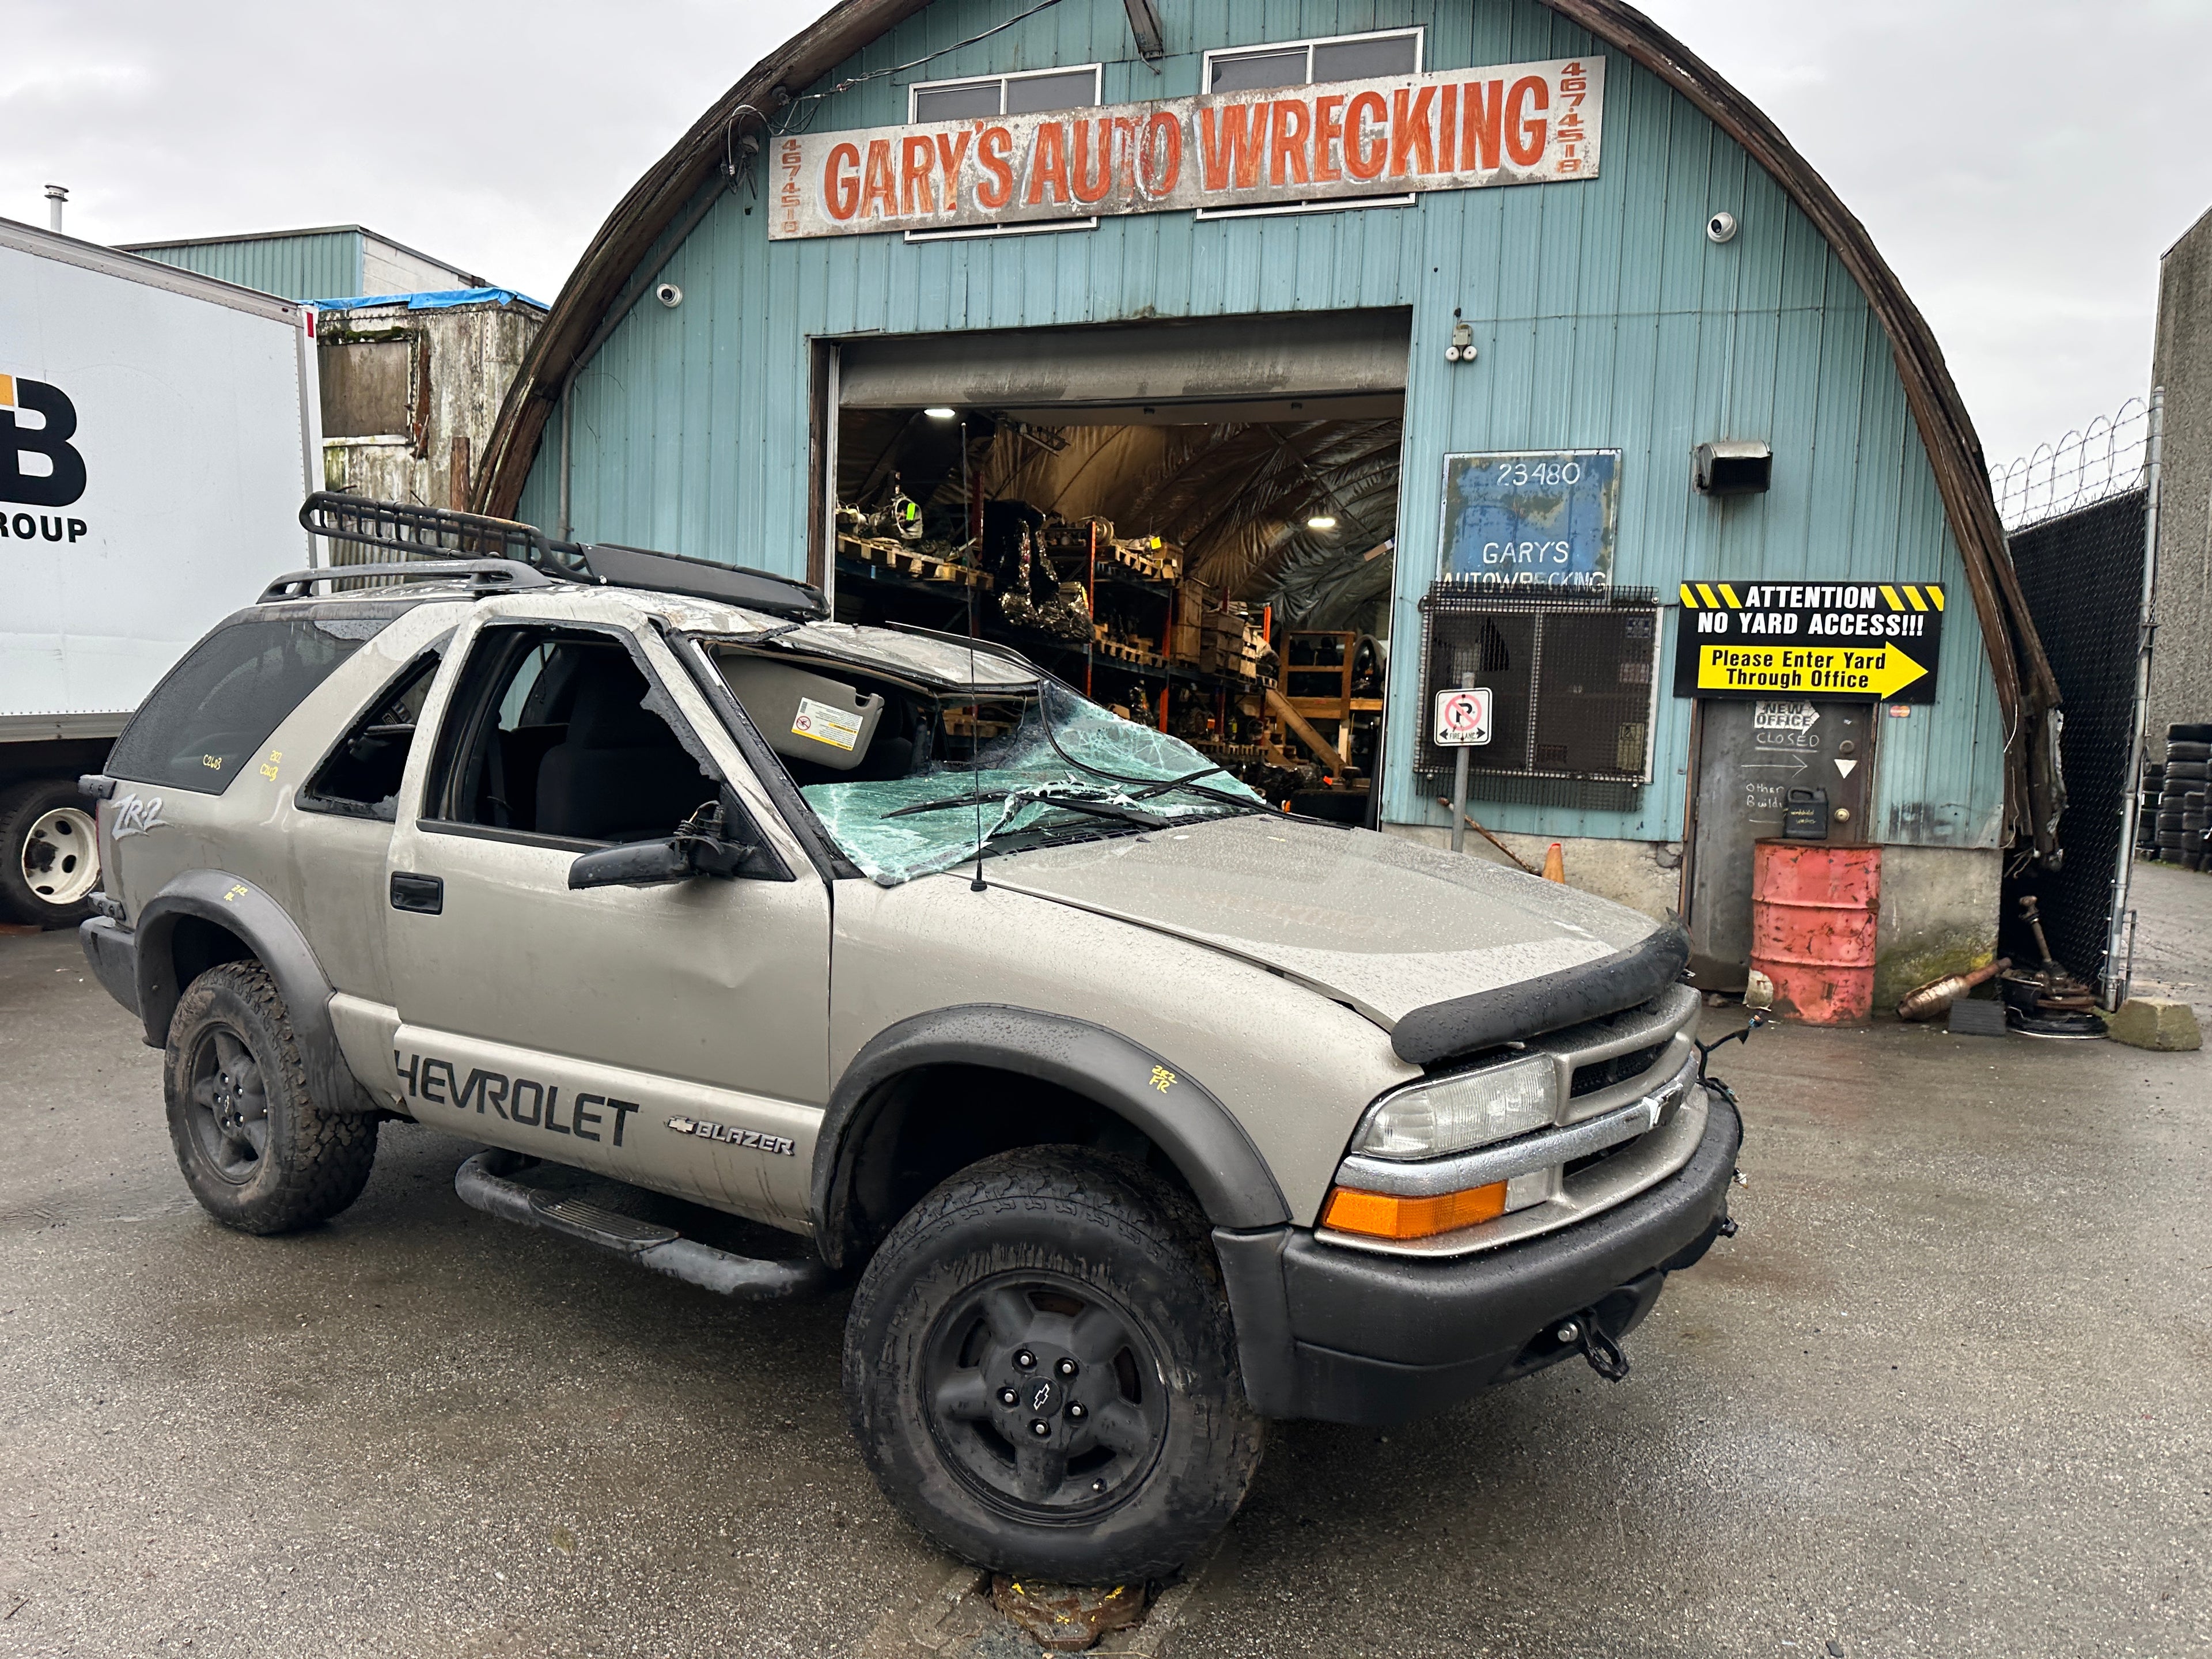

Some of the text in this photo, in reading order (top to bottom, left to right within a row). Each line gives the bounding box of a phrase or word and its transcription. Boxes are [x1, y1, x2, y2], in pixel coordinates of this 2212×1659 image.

[823, 75, 1549, 220] GARY'S AUTO WRECKING
[1498, 463, 1581, 486] 23480
[1483, 541, 1569, 564] GARY'S
[1745, 585, 1876, 609] ATTENTION
[1698, 612, 1924, 636] NO YARD ACCESS!!!
[1712, 650, 1886, 670] Please Enter Yard
[1726, 668, 1869, 688] Through Office
[1757, 713, 1811, 726] OFFICE
[1757, 732, 1820, 747] CLOSED
[1746, 783, 1784, 794] Other
[695, 1120, 795, 1156] BLAZER
